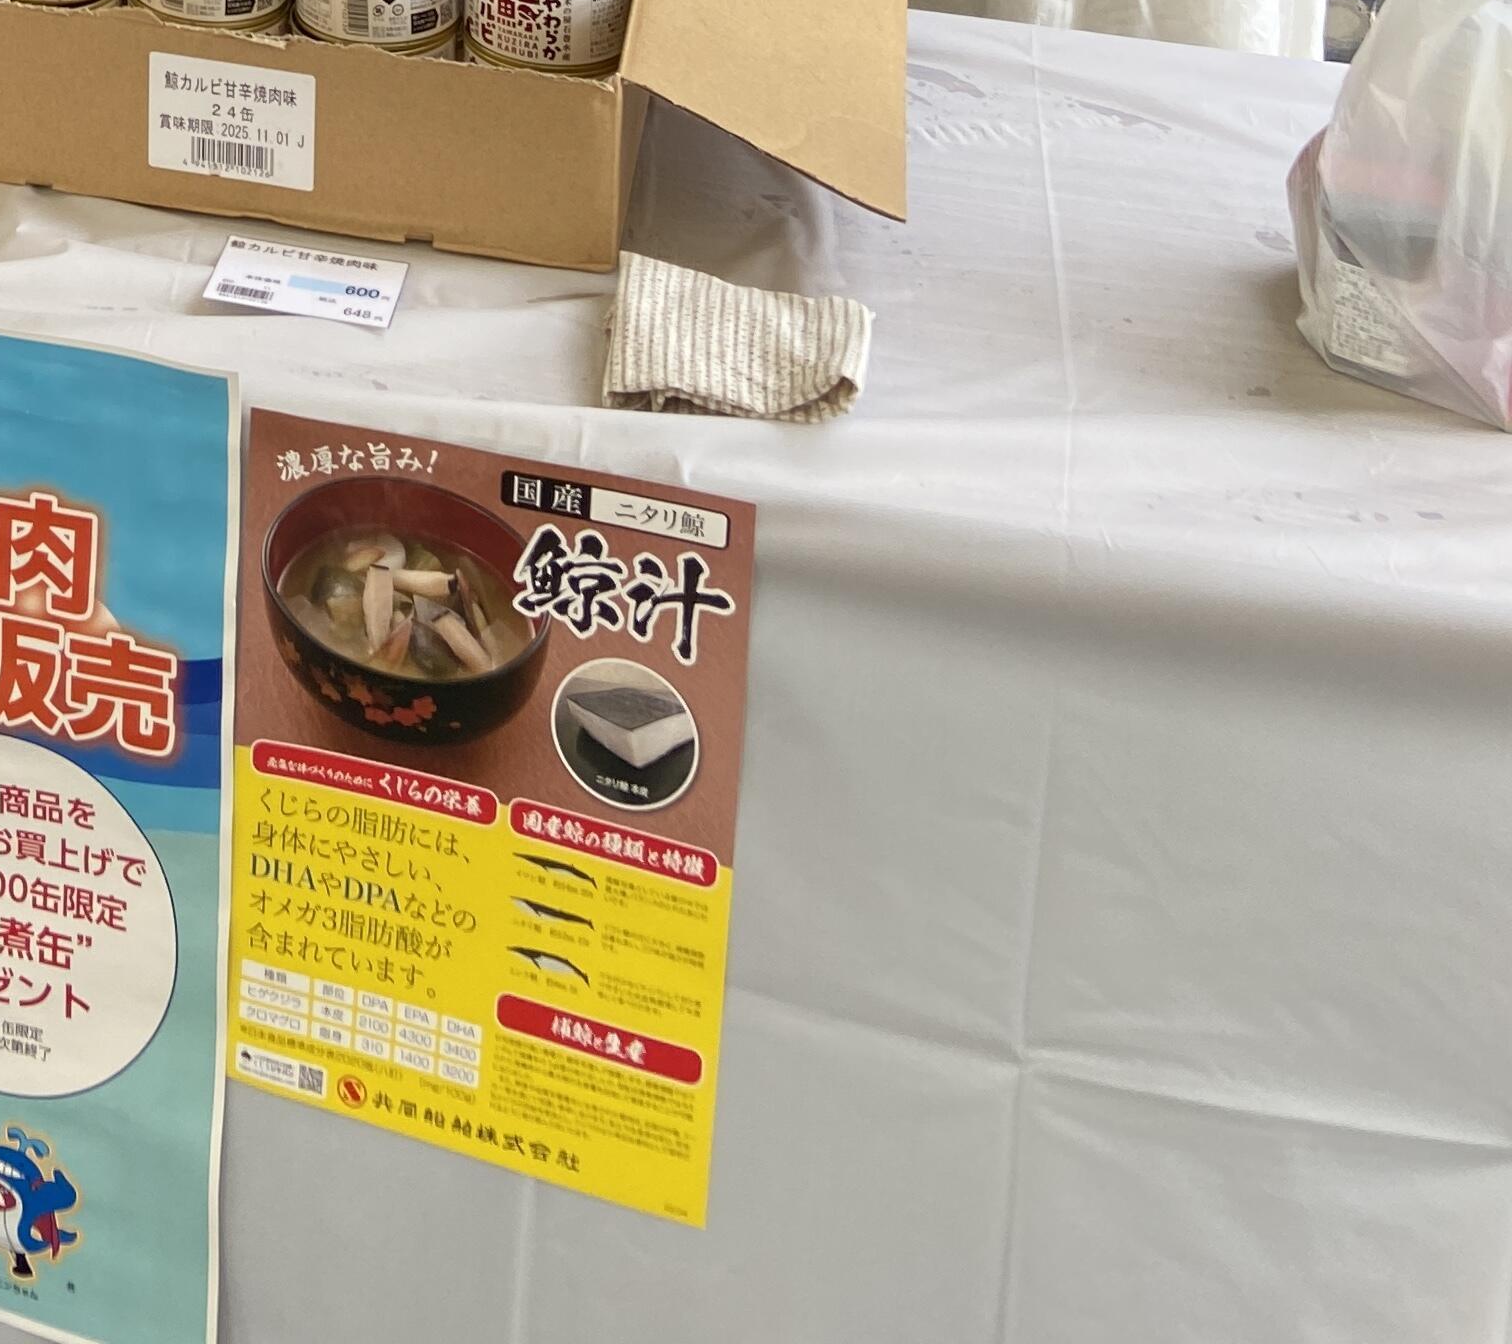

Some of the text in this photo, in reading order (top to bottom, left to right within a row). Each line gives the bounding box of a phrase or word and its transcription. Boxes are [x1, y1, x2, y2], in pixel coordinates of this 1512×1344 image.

[164, 70, 297, 108] 鯨カルビ甘辛焼肉味
[160, 114, 215, 136] 賞味期限
[276, 441, 439, 482] 濃厚な旨み!
[512, 474, 707, 538] 国産 ニタリ鯨
[512, 522, 736, 666] 鯨汁
[252, 820, 442, 892] 身体にやさしい、
[260, 788, 470, 864] くじらの脂肪には、
[249, 889, 453, 960] オメガ3脂肪酸が
[251, 853, 477, 933] DHAやDPAなどの
[246, 922, 436, 999] 含まれています。
[246, 1006, 301, 1031] クロマグロ
[362, 1039, 384, 1055] 310
[400, 1049, 430, 1068] 1400
[247, 985, 301, 1009] ヒゲクジラ
[399, 1029, 432, 1048] 4300
[444, 1041, 477, 1061] 3400
[362, 994, 389, 1011] DPA
[404, 1007, 430, 1024] EPA
[447, 1020, 476, 1038] DHA
